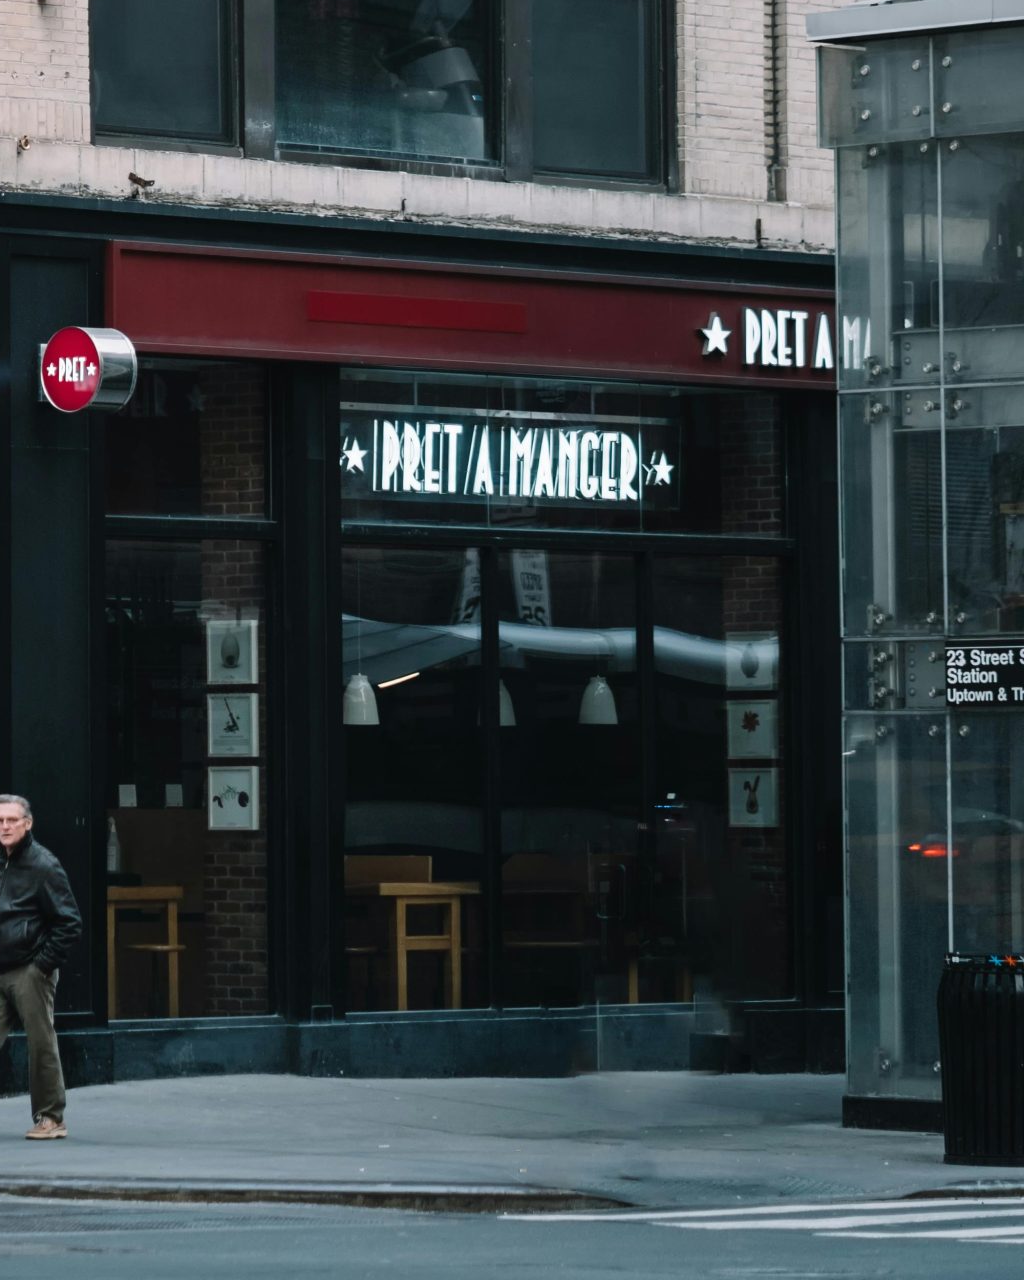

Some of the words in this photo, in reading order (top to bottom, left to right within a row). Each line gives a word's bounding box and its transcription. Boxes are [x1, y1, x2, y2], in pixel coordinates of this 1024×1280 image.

[744, 307, 809, 368] PRET
[814, 313, 834, 369] A
[58, 356, 87, 383] PRET
[382, 420, 464, 494] PRET
[473, 424, 494, 495] A
[509, 425, 639, 500] MANGER
[946, 649, 966, 667] 23
[970, 649, 1015, 666] Street
[947, 667, 998, 685] Station
[947, 687, 994, 705] Uptown
[997, 686, 1008, 702] &
